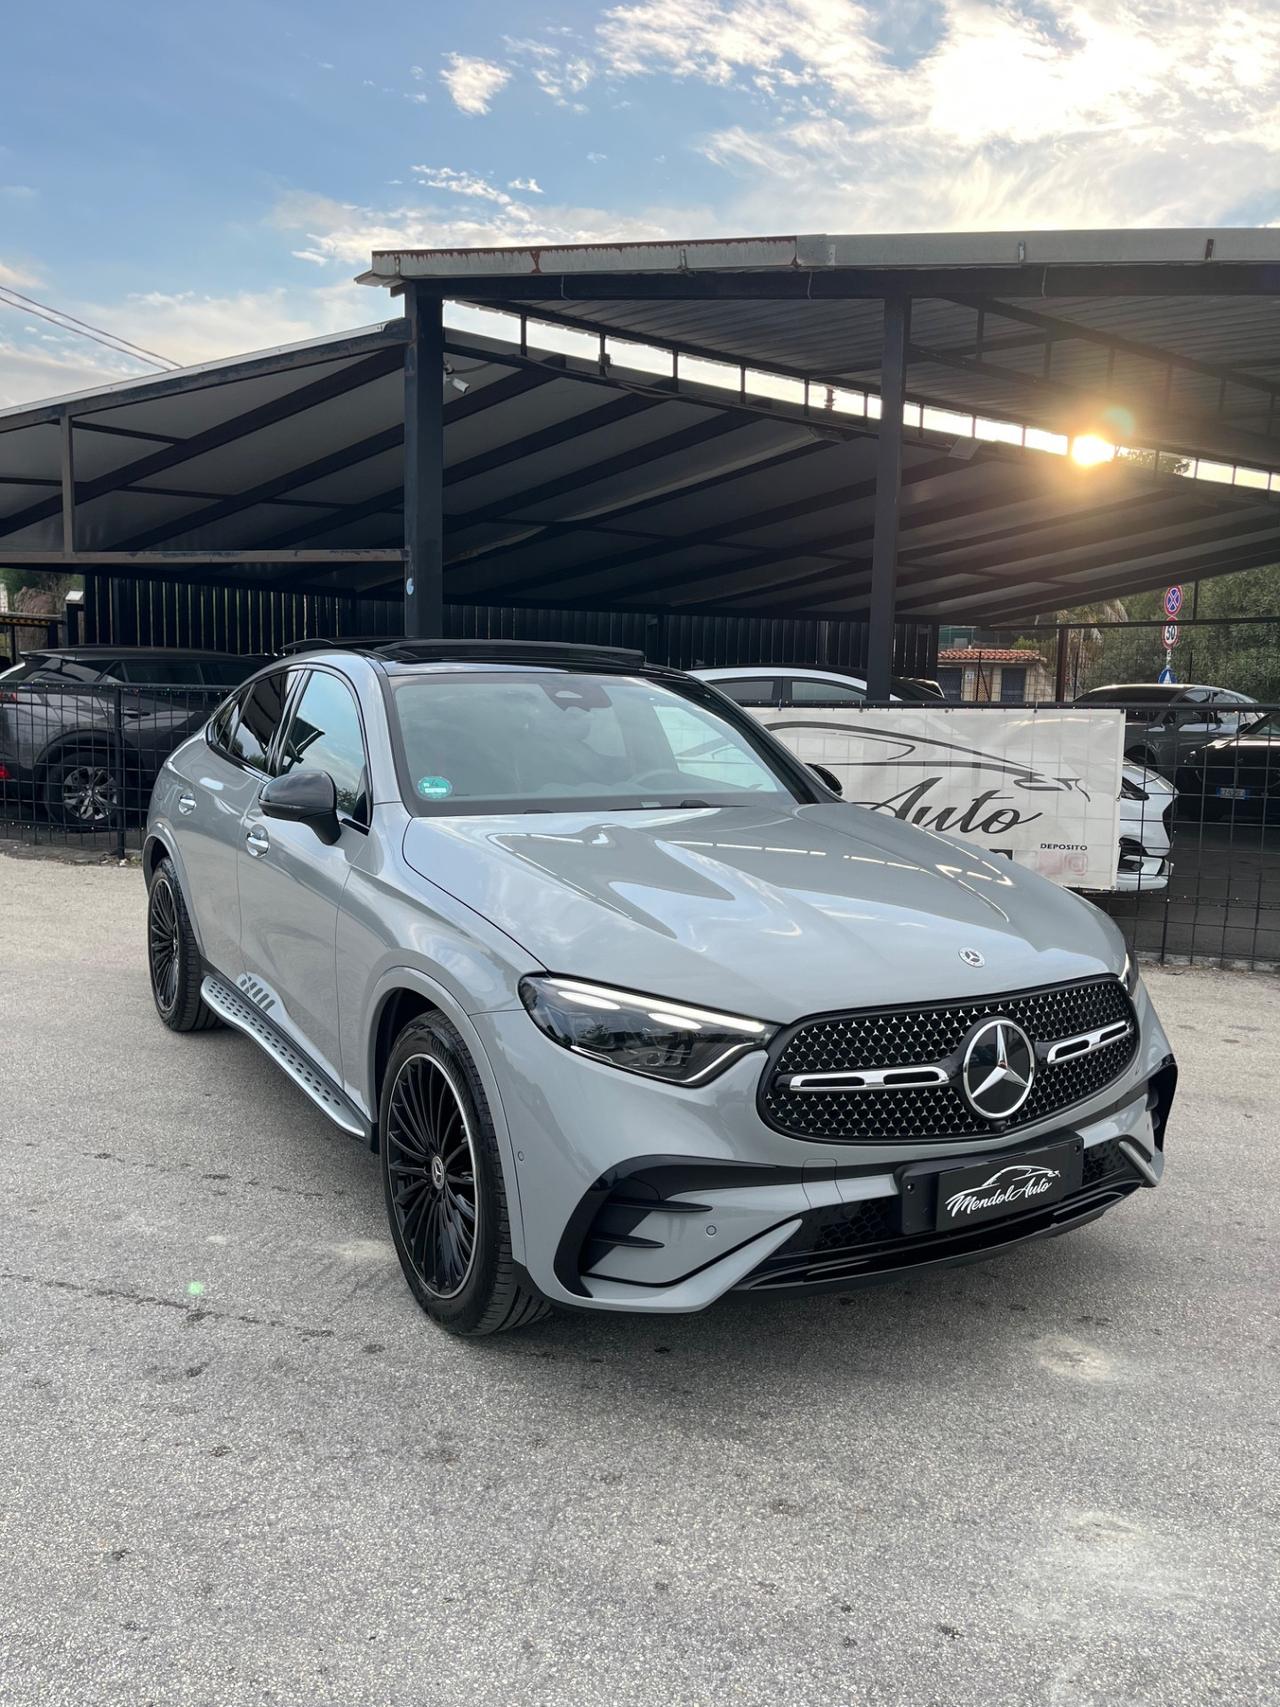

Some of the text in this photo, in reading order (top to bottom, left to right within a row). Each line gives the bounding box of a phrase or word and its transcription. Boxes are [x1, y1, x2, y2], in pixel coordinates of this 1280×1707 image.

[1166, 625, 1176, 641] 50
[852, 776, 1044, 834] Auto
[1040, 843, 1088, 851] DEPOSITO
